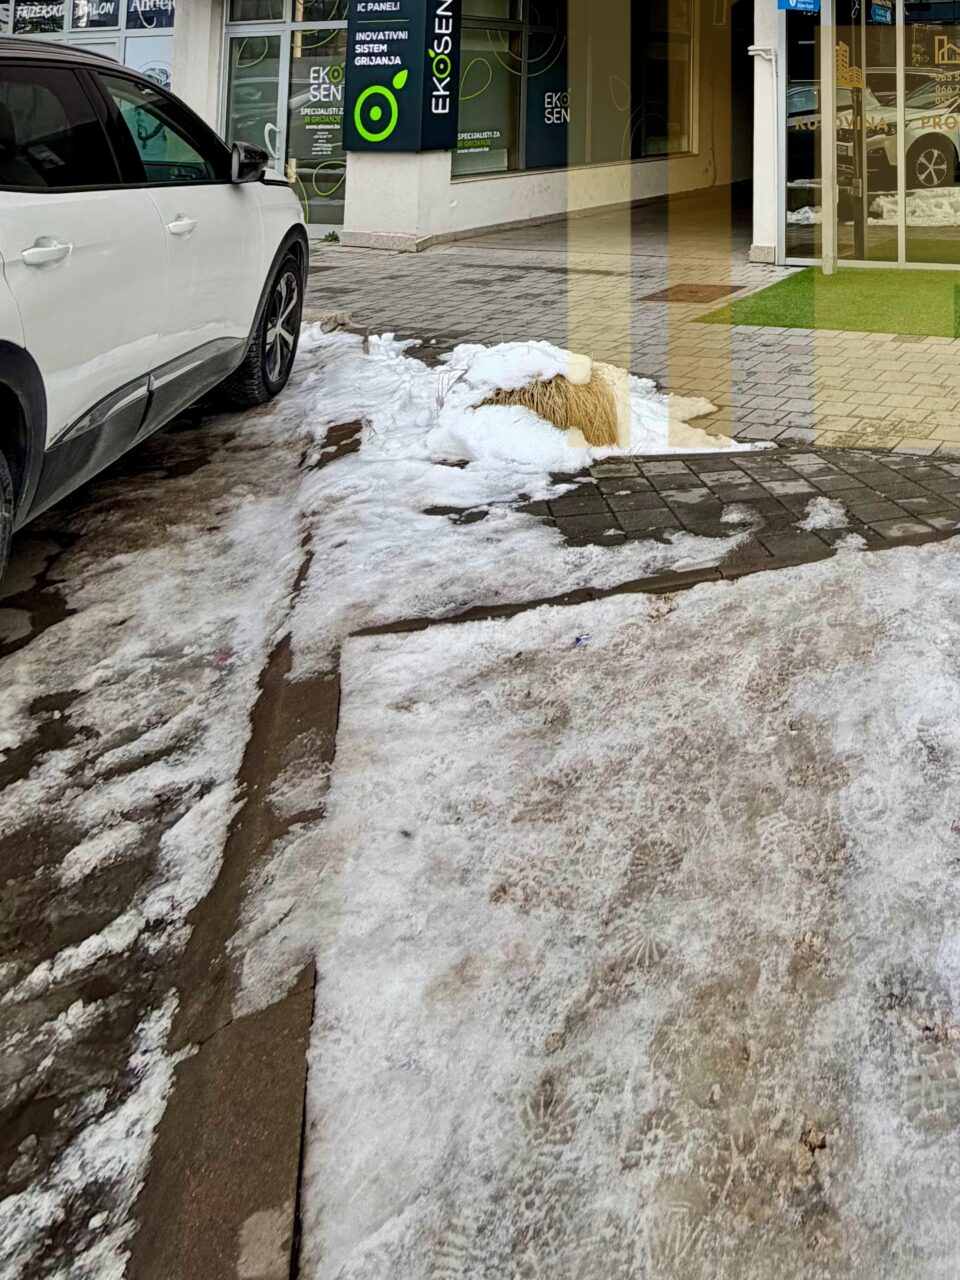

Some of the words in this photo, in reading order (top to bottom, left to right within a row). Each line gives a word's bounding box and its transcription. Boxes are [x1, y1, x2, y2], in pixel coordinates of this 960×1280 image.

[357, 3, 366, 12] IC
[367, 1, 400, 12] PANELI
[355, 31, 409, 41] INOVATIVNI
[355, 44, 388, 54] SISTEM
[354, 56, 402, 66] GRIJANJA
[309, 65, 343, 84] EKO
[309, 84, 342, 102] SEN
[935, 85, 952, 93] 066
[544, 92, 570, 108] EKO
[544, 108, 570, 124] SEN
[794, 116, 888, 132] KUOVINA
